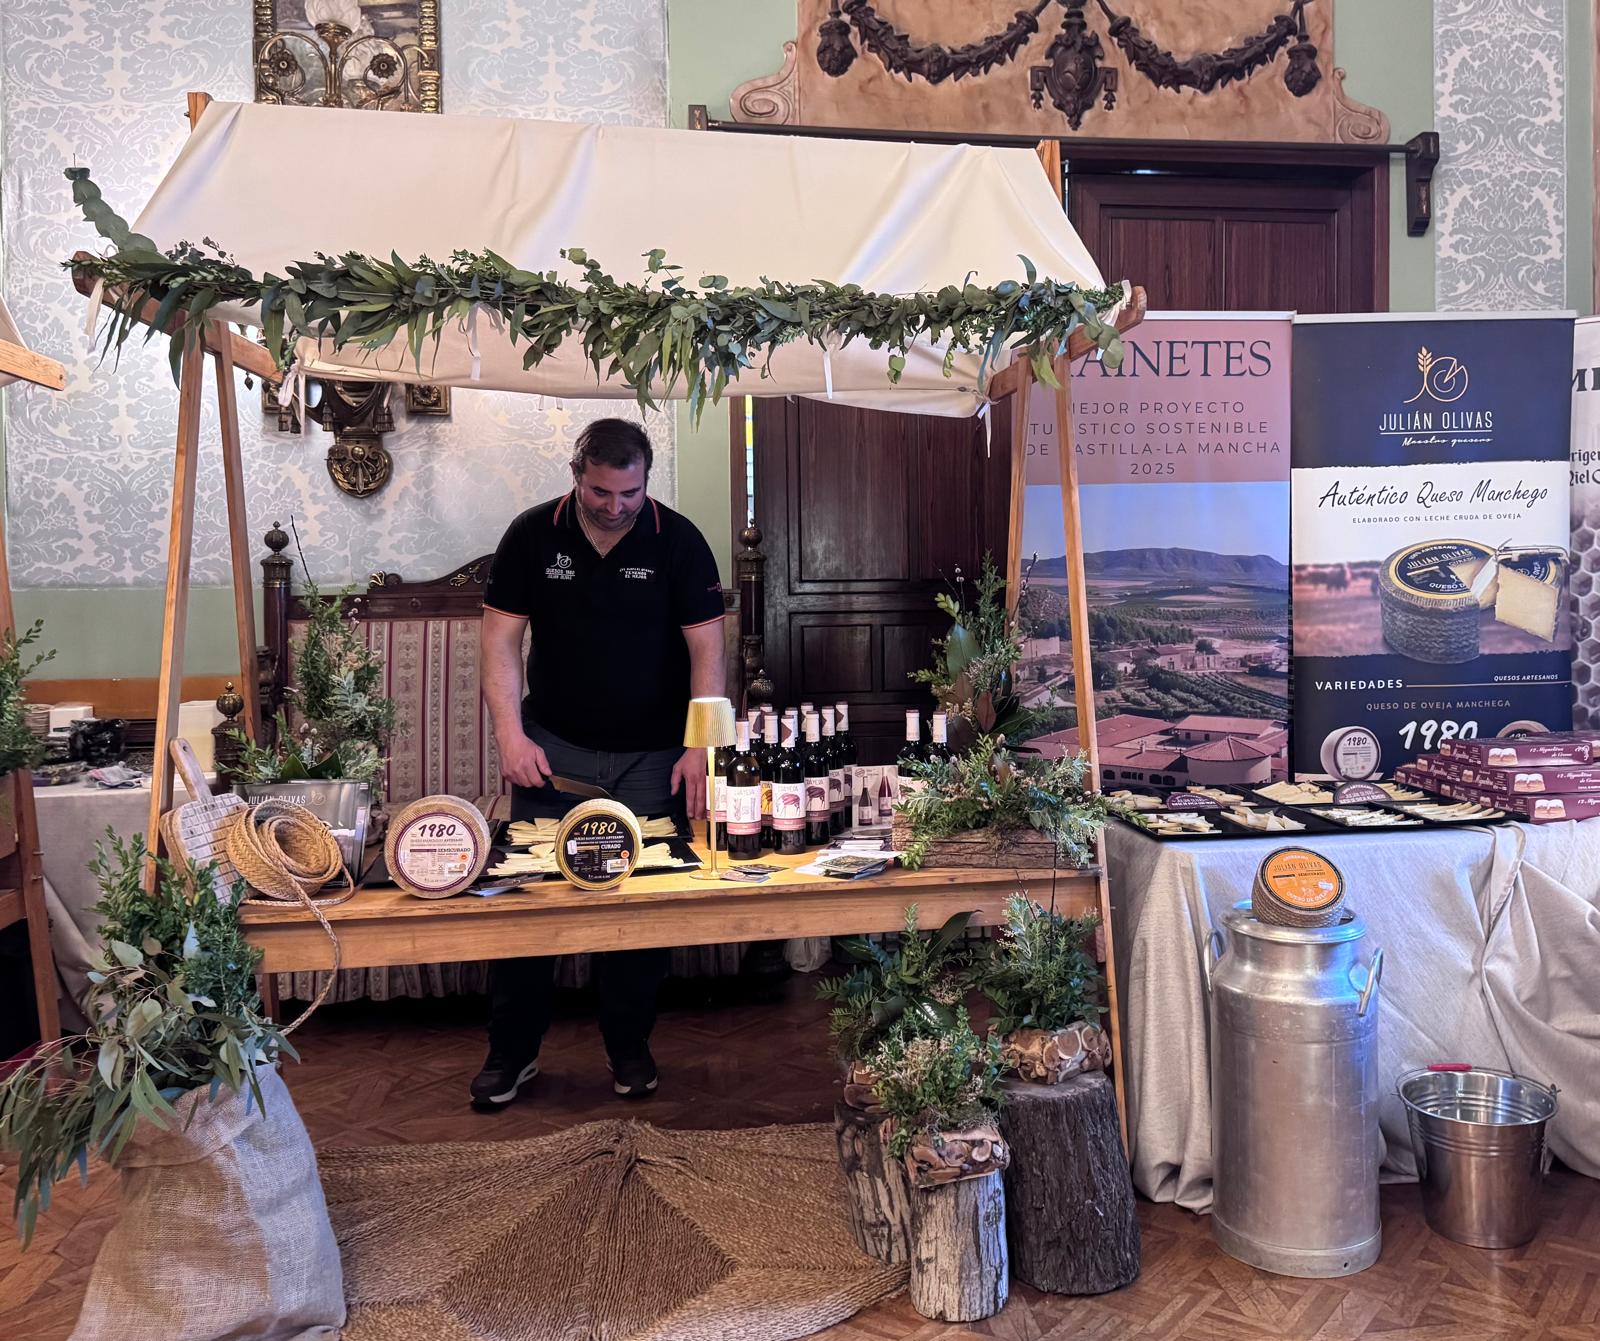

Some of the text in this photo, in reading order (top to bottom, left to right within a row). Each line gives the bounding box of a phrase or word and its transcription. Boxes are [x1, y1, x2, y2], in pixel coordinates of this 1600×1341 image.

[1071, 340, 1272, 377] AINETES
[1072, 401, 1245, 415] EJOR PROYECTO
[1378, 410, 1494, 431] JULIÁN OLIVAS
[1030, 421, 1269, 436] TUSTICO SOSTENIBLE
[1075, 443, 1188, 455] ASTILLA-LA
[1198, 441, 1281, 454] MANCHA
[1130, 462, 1176, 475] 2025
[1318, 478, 1549, 509] Auténtico Queso Manchego
[1352, 512, 1522, 525] ELABORADO CON LECHE CRUDA DE OVEJA
[1314, 678, 1404, 691] VARIEDADES
[1493, 673, 1559, 682] QUESOS ARTESANOS
[1365, 699, 1511, 711] QUESO DE OVEJA MANCHEGA
[1346, 736, 1368, 747] 1980
[418, 823, 457, 838] 1980
[580, 821, 617, 836] 1980
